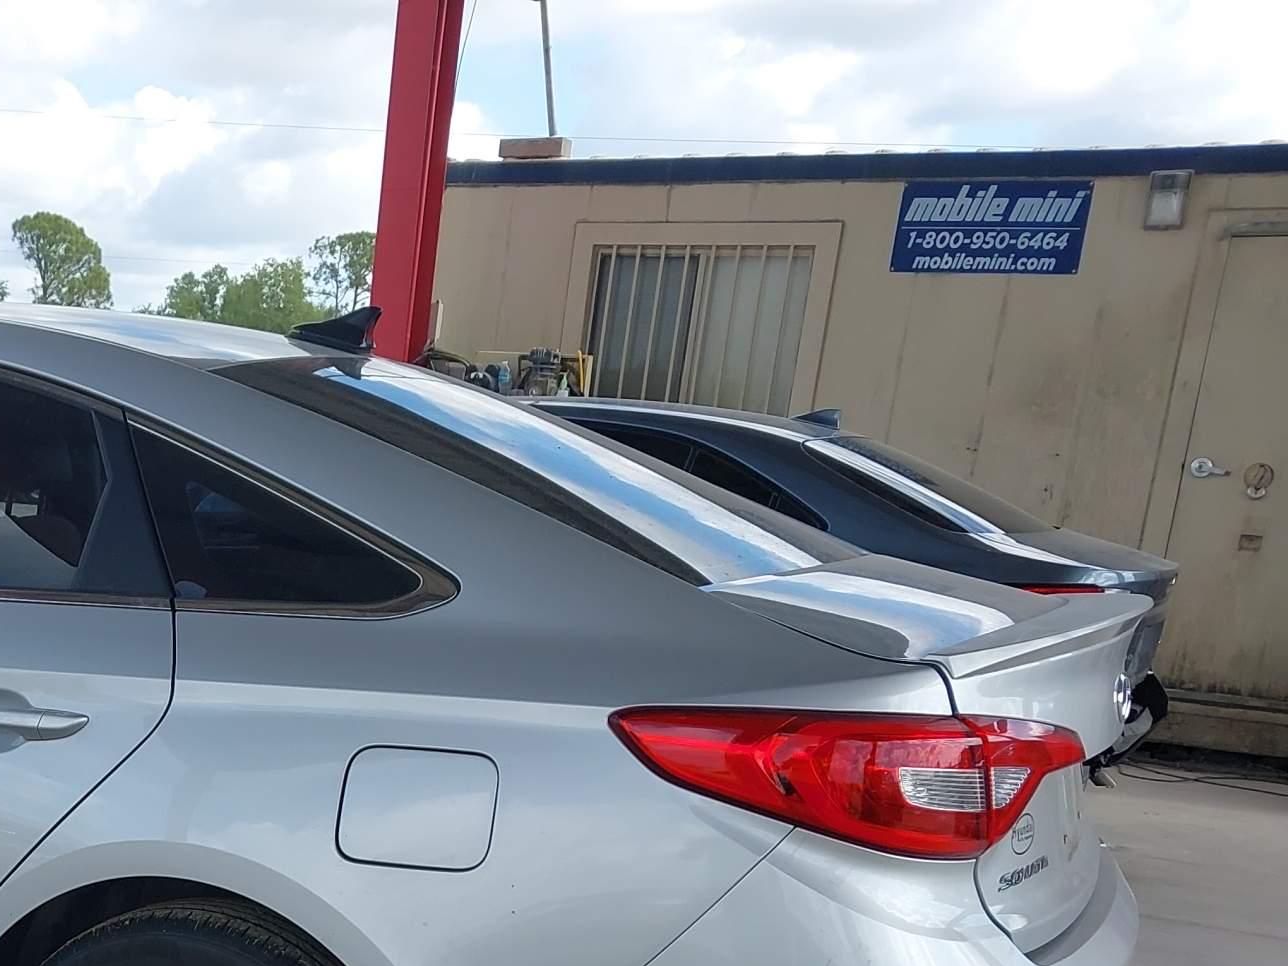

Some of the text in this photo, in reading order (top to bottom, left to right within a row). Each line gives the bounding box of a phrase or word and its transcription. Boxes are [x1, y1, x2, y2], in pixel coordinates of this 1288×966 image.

[904, 184, 1084, 222] mobile mini
[907, 231, 1069, 250] 1-800-950-6464
[912, 252, 1057, 271] mobilemini.com
